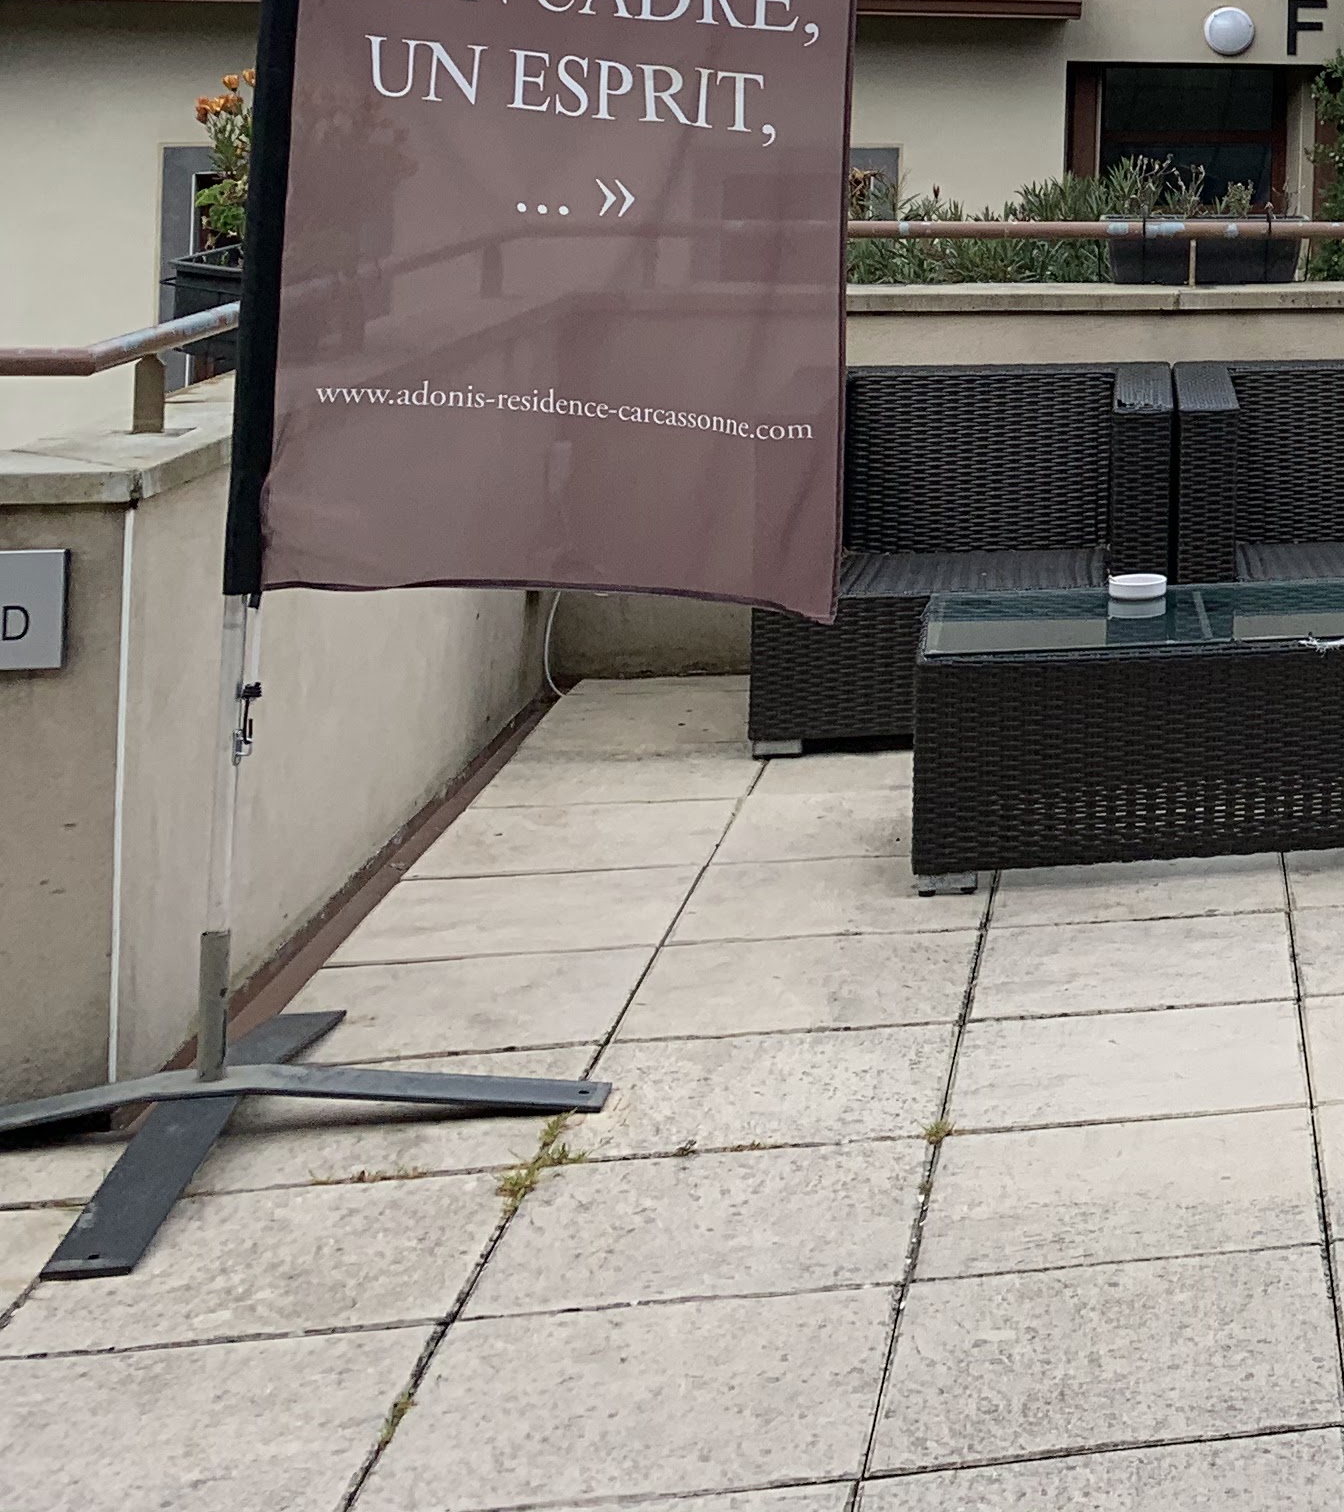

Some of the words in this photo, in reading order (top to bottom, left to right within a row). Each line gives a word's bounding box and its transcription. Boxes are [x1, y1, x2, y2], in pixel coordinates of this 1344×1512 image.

[364, 34, 489, 106] UN
[506, 48, 777, 147] ESPRIT,
[315, 379, 814, 441] www.adonis-residence-carcassonne.com
[2, 604, 30, 641] D
